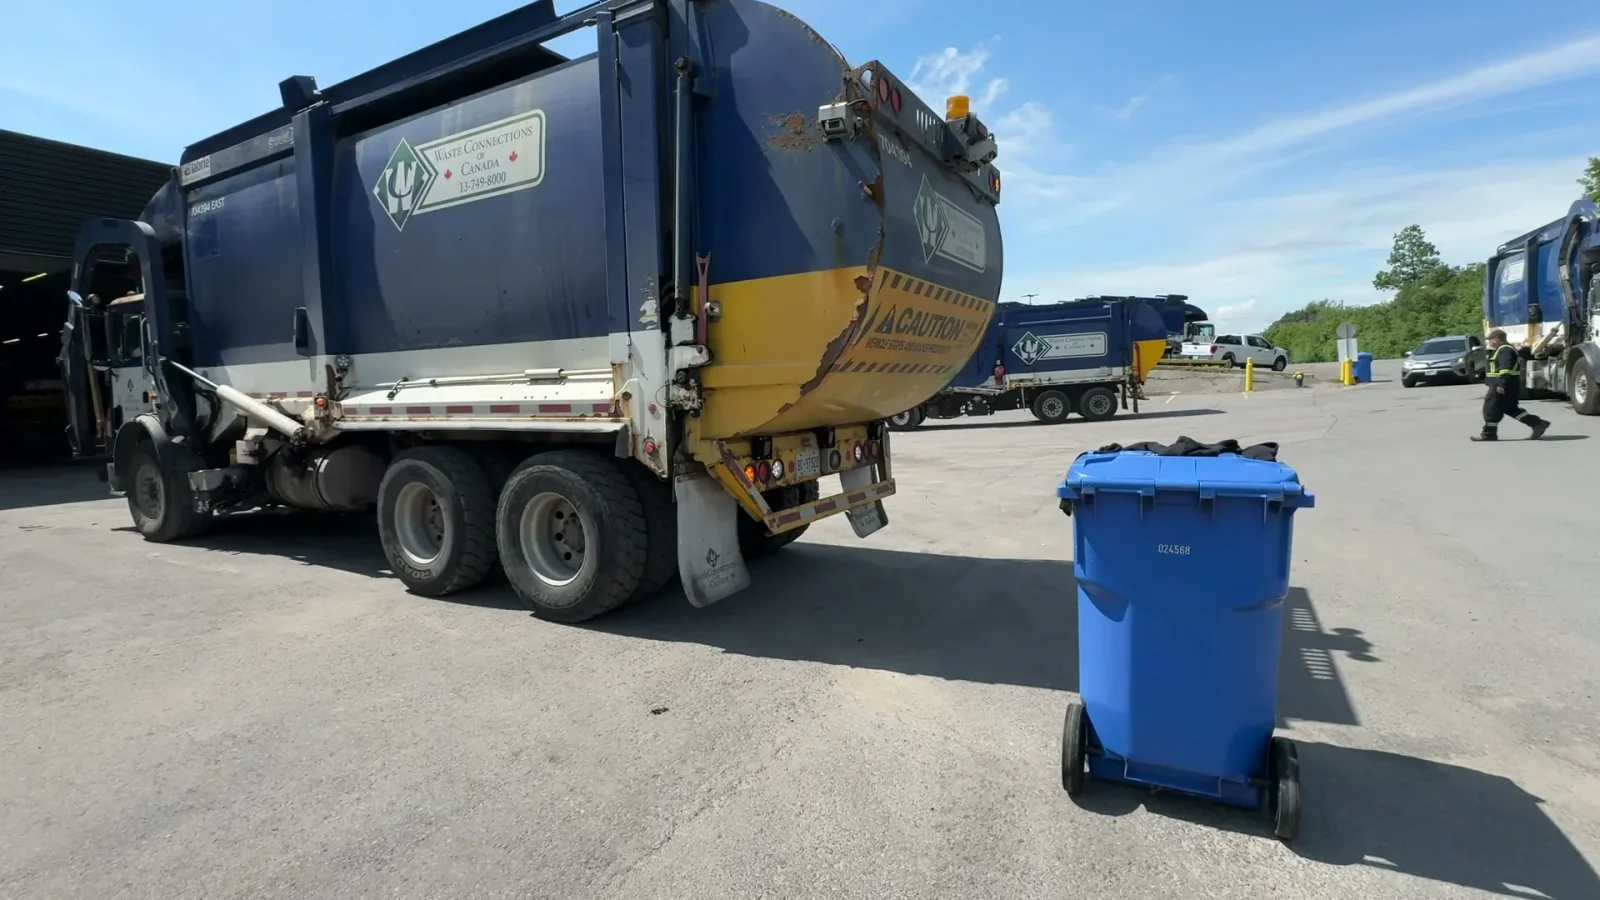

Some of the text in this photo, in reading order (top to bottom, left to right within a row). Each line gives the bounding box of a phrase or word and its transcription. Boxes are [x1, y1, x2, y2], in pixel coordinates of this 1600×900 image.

[434, 126, 533, 162] WASTE CONNECTIONS
[460, 158, 500, 176] CANADA
[190, 197, 225, 217] 704394 EAST
[895, 307, 966, 341] CAUTION
[1158, 543, 1191, 555] 024568
